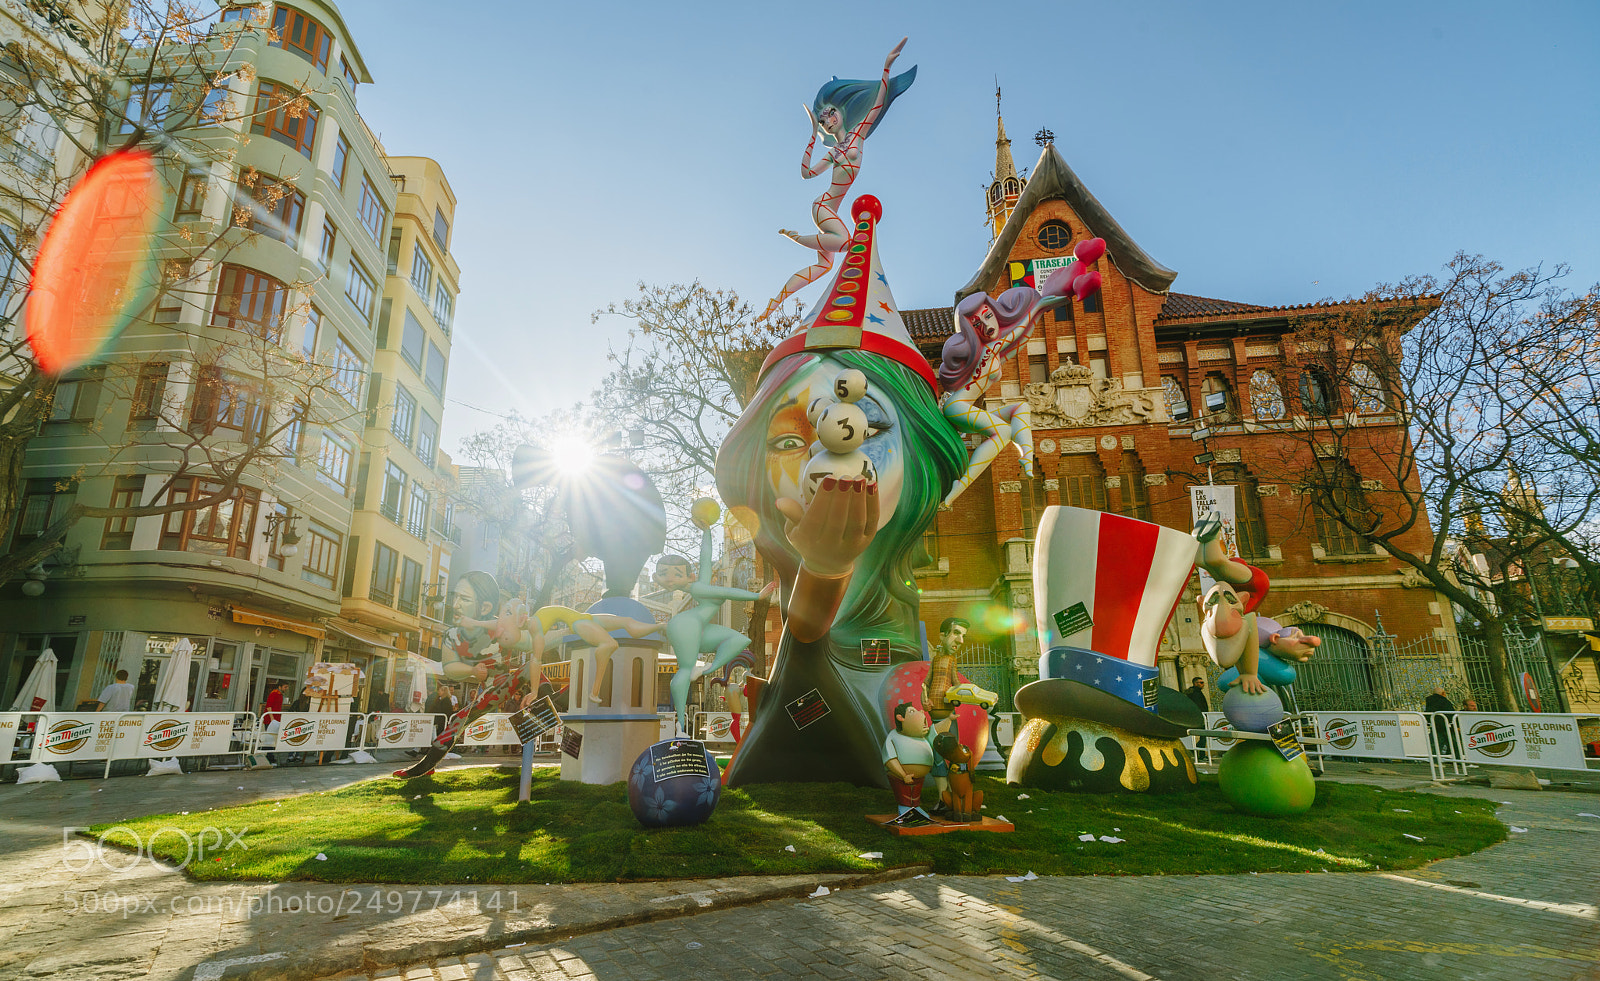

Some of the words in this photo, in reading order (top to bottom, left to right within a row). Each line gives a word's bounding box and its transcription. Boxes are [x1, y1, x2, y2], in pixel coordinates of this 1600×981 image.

[837, 379, 849, 398] 5
[837, 417, 855, 441] 3
[1361, 719, 1397, 727] EXPLORING
[1521, 722, 1573, 732] EXPLORING
[1522, 730, 1541, 738] THE
[1523, 736, 1557, 745] WORLD
